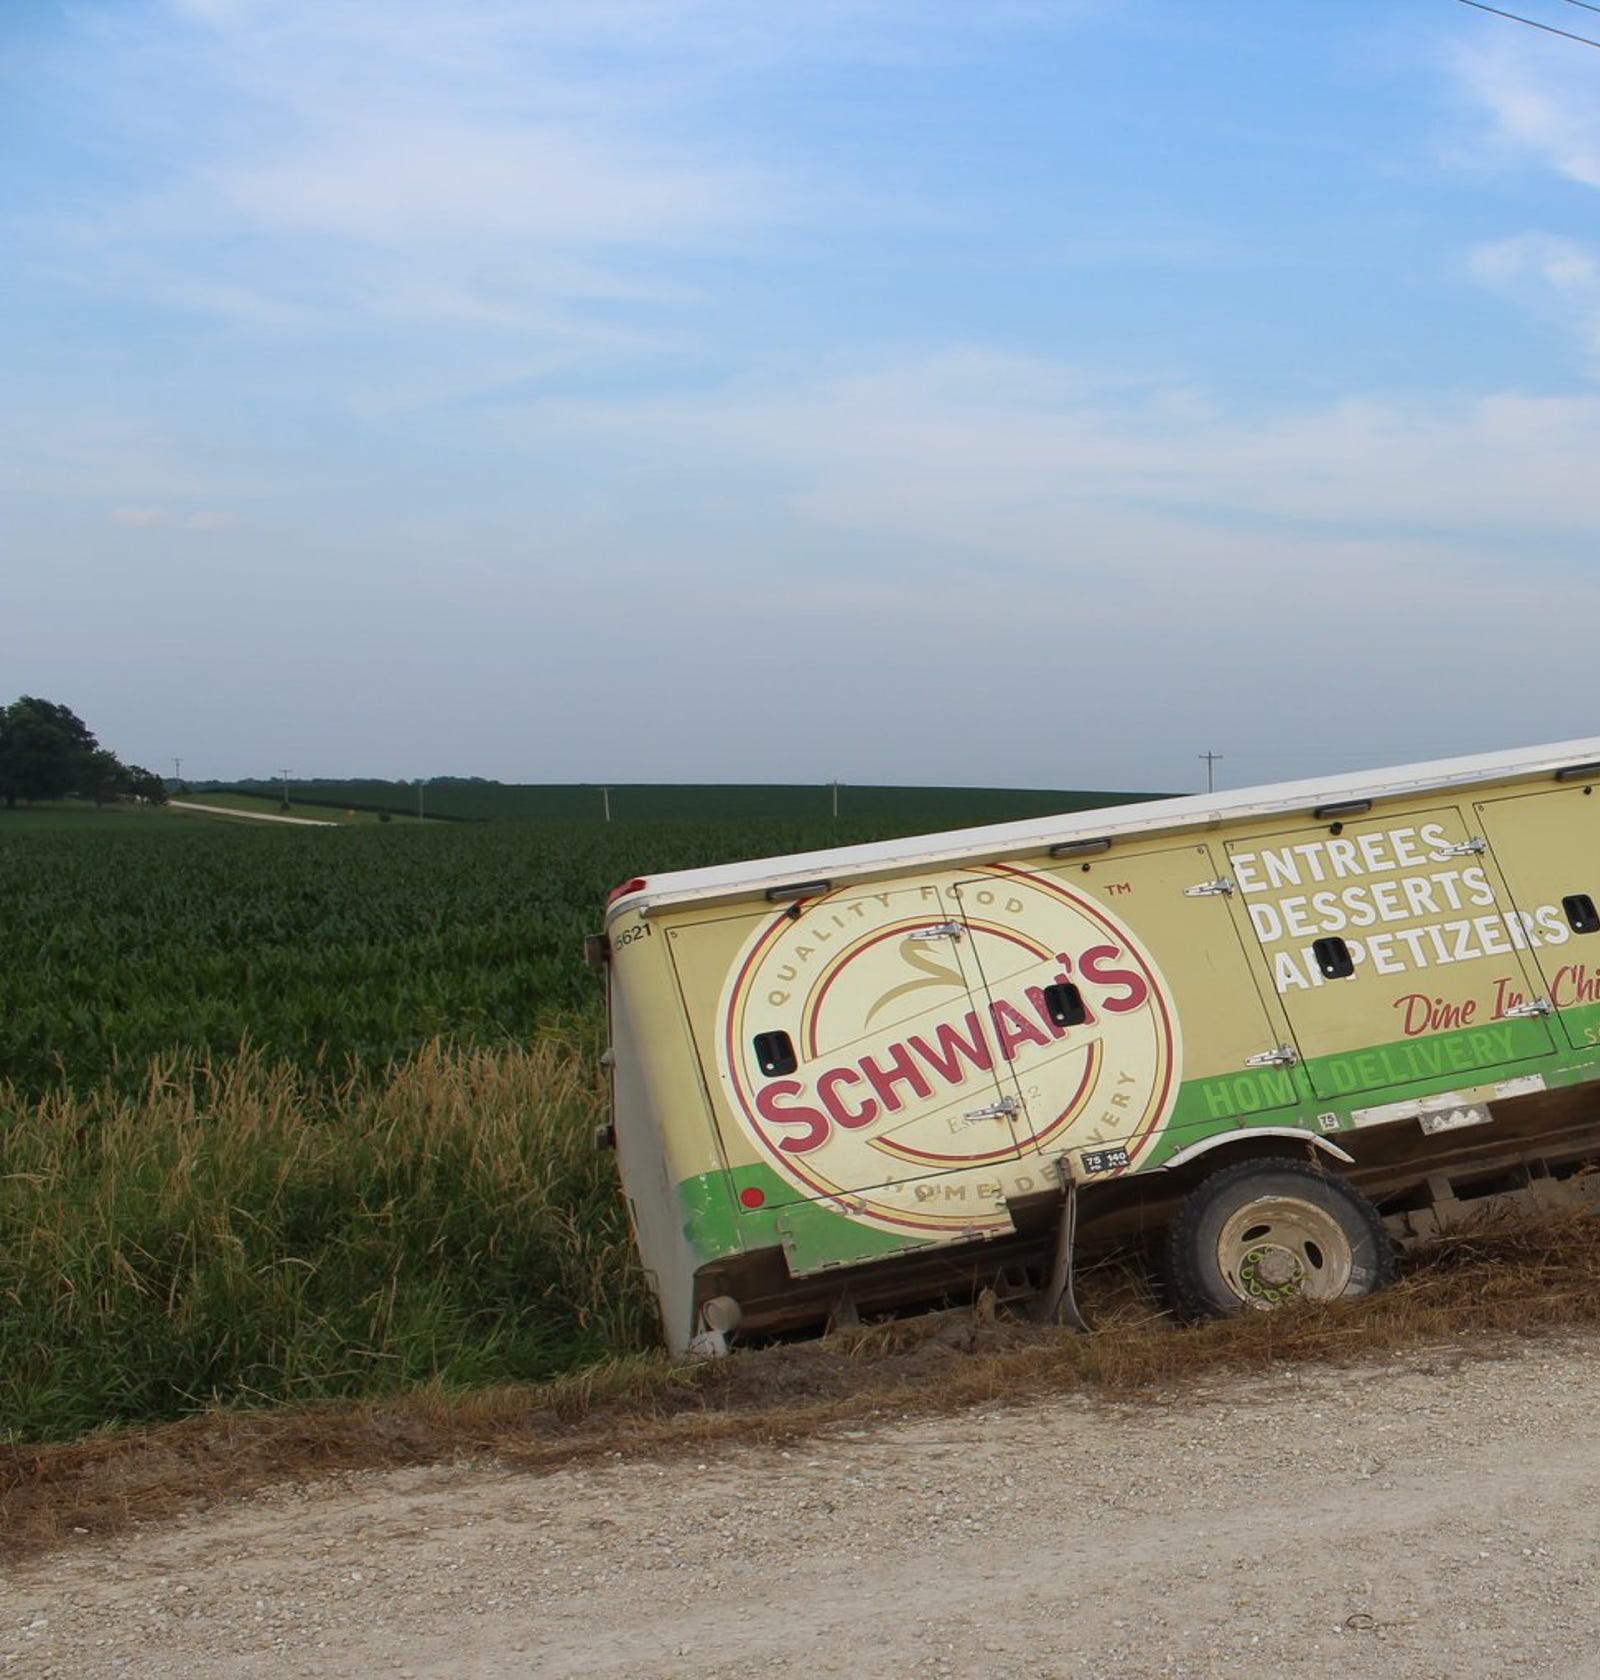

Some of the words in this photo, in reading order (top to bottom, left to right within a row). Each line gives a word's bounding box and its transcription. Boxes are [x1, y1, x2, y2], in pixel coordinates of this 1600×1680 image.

[1104, 882, 1131, 896] TM
[1230, 824, 1448, 893] ENTREES
[768, 892, 891, 1007] QUALITY
[920, 885, 1025, 914] FOOD
[1248, 867, 1497, 943] DESSERTS
[1393, 993, 1476, 1036] Dine
[1491, 977, 1524, 1018] In
[756, 945, 1148, 1153] SCHWAN'S
[1203, 1066, 1314, 1117] HOM
[1330, 1026, 1516, 1091] DELIVERY
[1014, 1071, 1137, 1192] DEVERY
